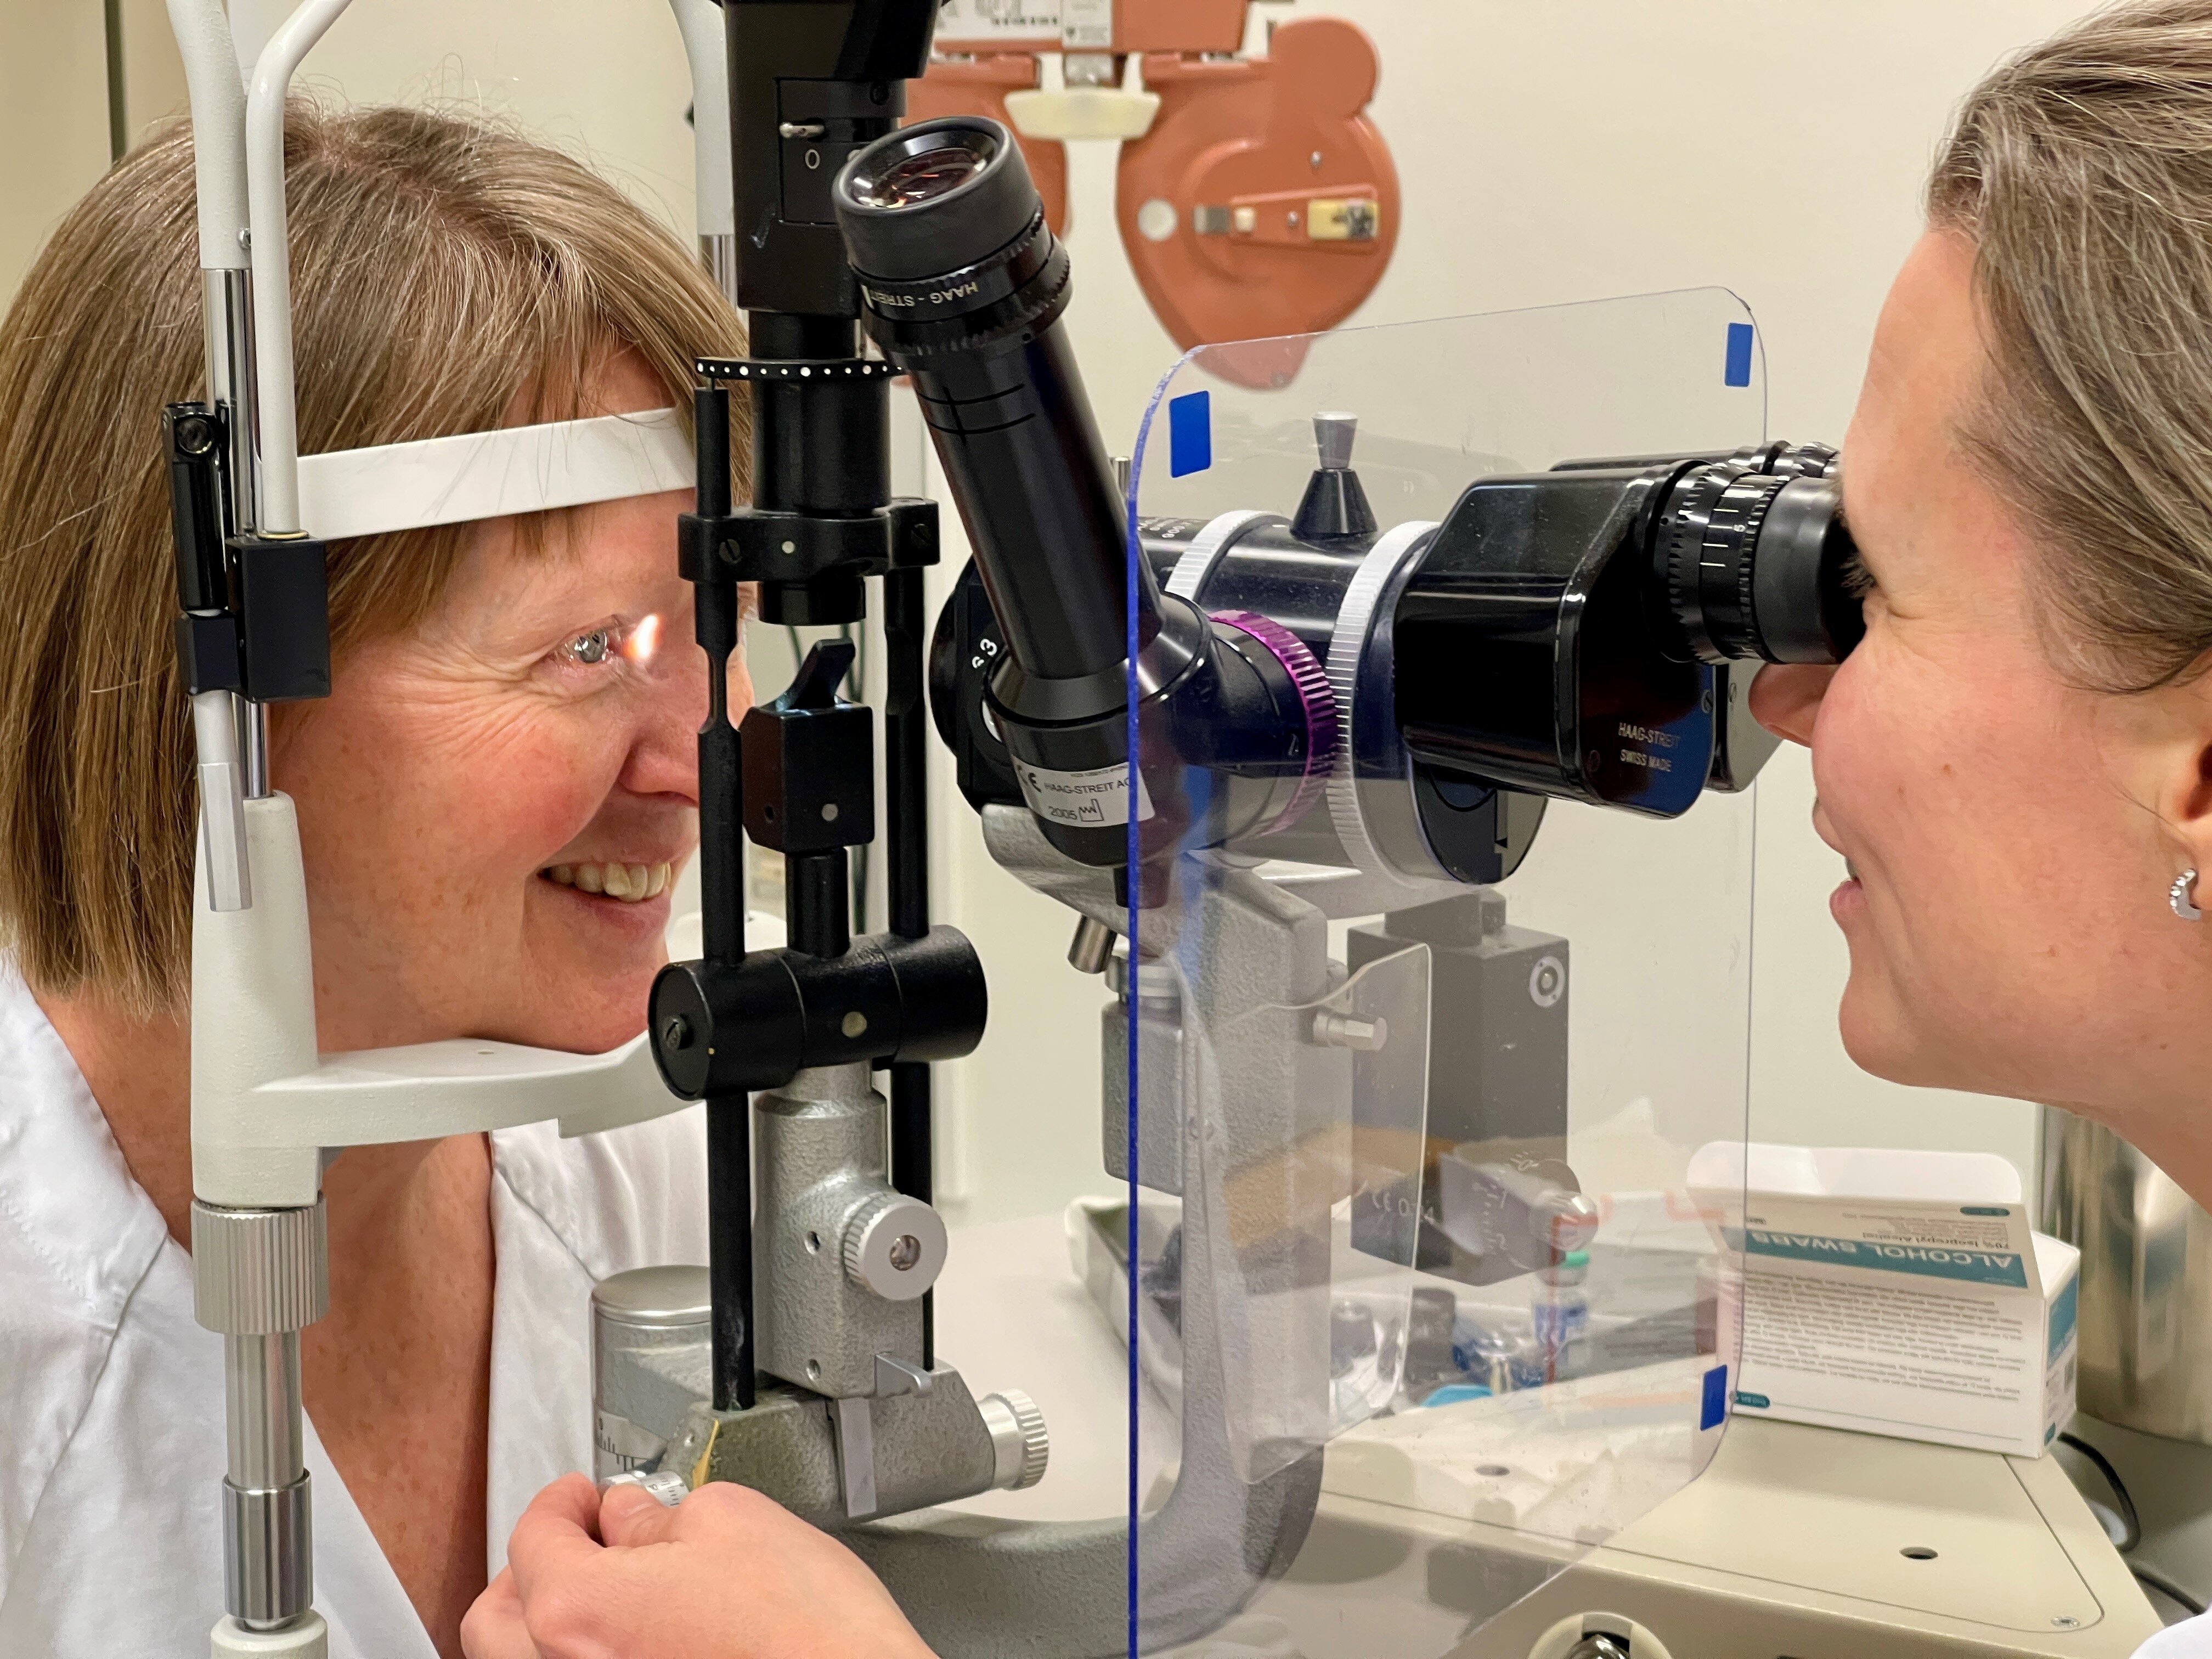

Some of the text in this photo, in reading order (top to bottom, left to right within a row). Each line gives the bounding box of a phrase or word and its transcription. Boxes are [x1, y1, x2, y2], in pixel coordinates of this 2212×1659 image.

[929, 281, 979, 304] HAAG
[1618, 722, 1681, 748] HAAG-STREIT
[1620, 749, 1672, 772] SWISS MADE
[1044, 781, 1114, 794] HAAG-STREIT
[1048, 805, 1077, 820] 2005
[1751, 1231, 2012, 1268] ALCOHOL SWABS
